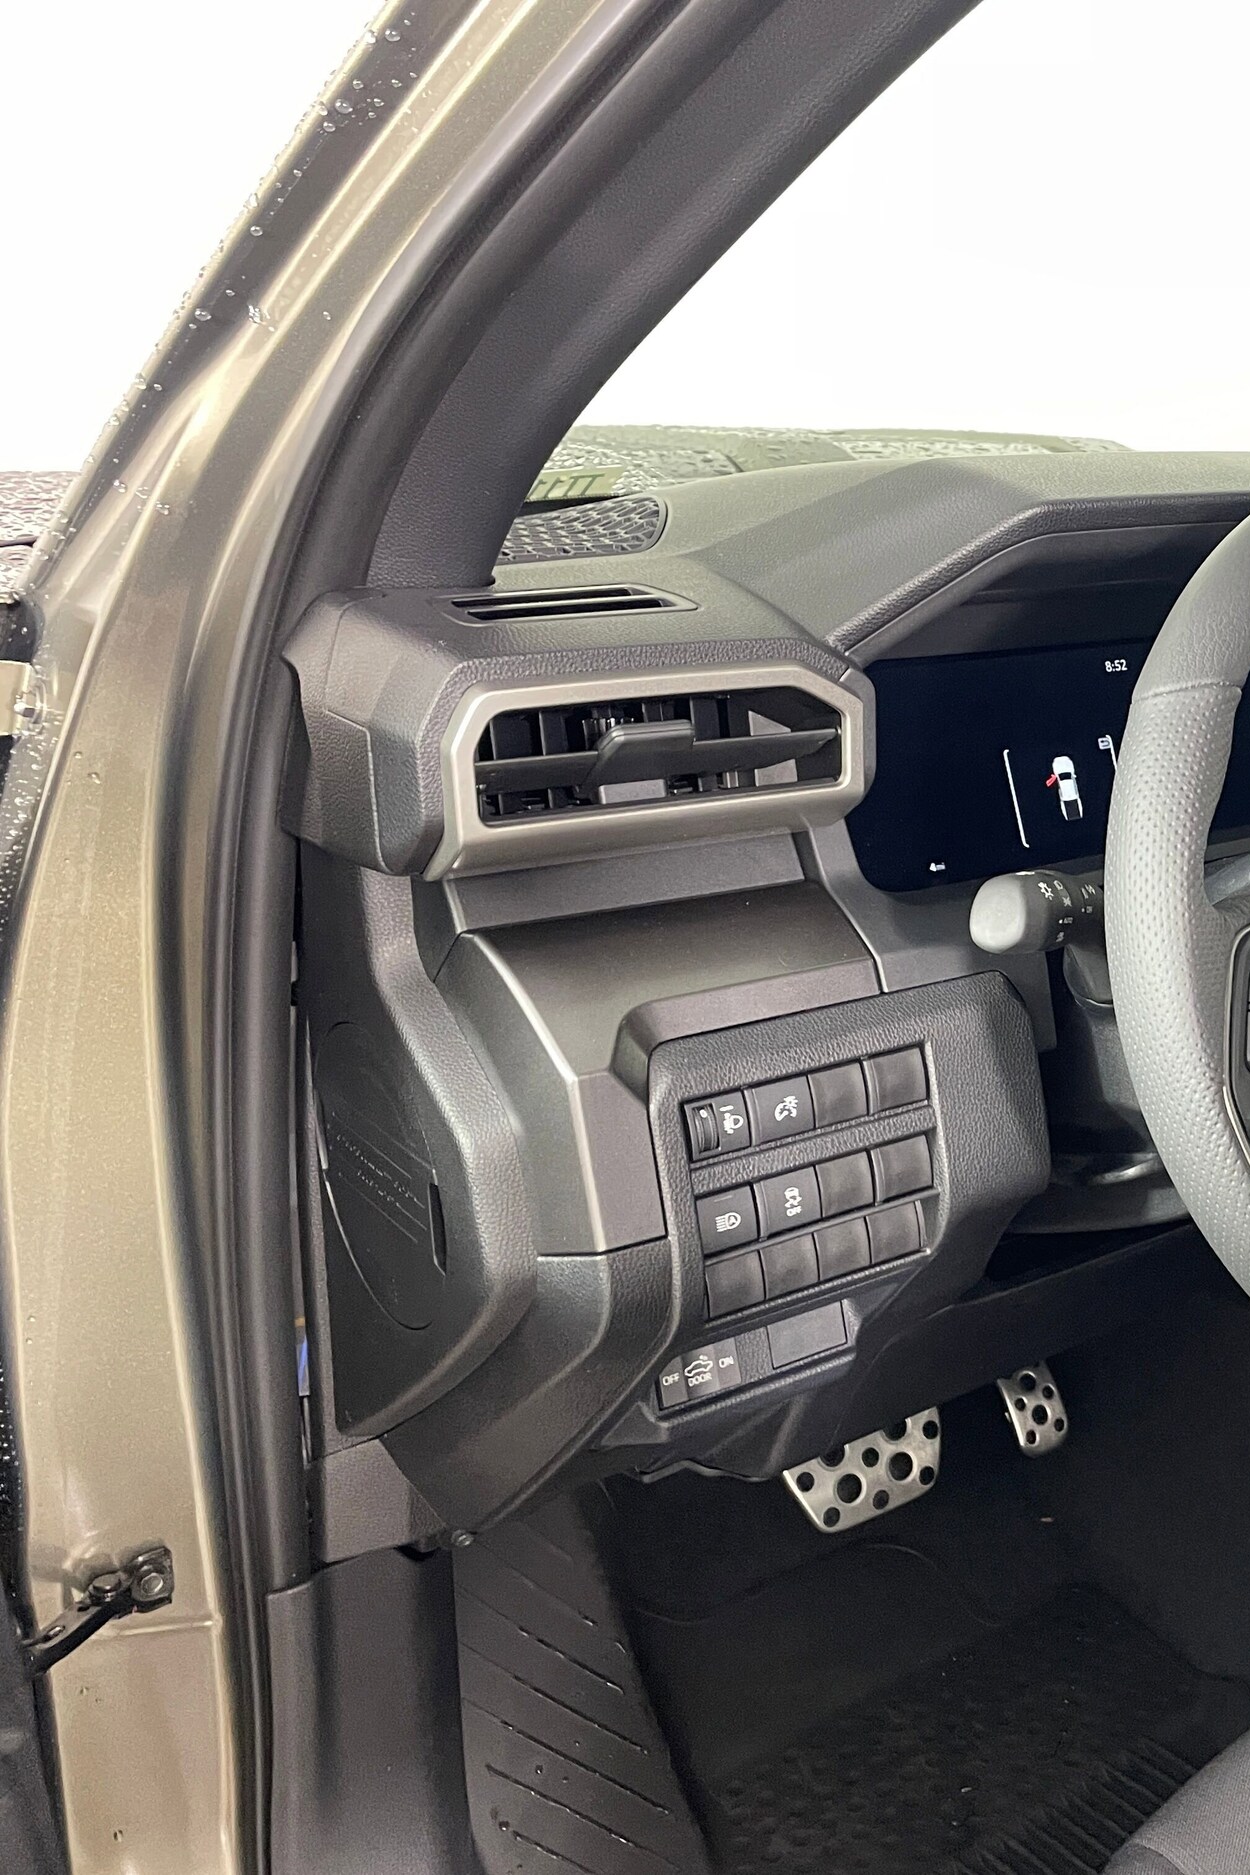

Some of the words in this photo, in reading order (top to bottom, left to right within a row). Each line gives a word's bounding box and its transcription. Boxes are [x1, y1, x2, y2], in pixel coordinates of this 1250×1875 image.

[1104, 659, 1128, 672] 8:52
[718, 1355, 735, 1368] ON
[662, 1372, 680, 1386] OFF
[687, 1372, 713, 1387] DOOR
